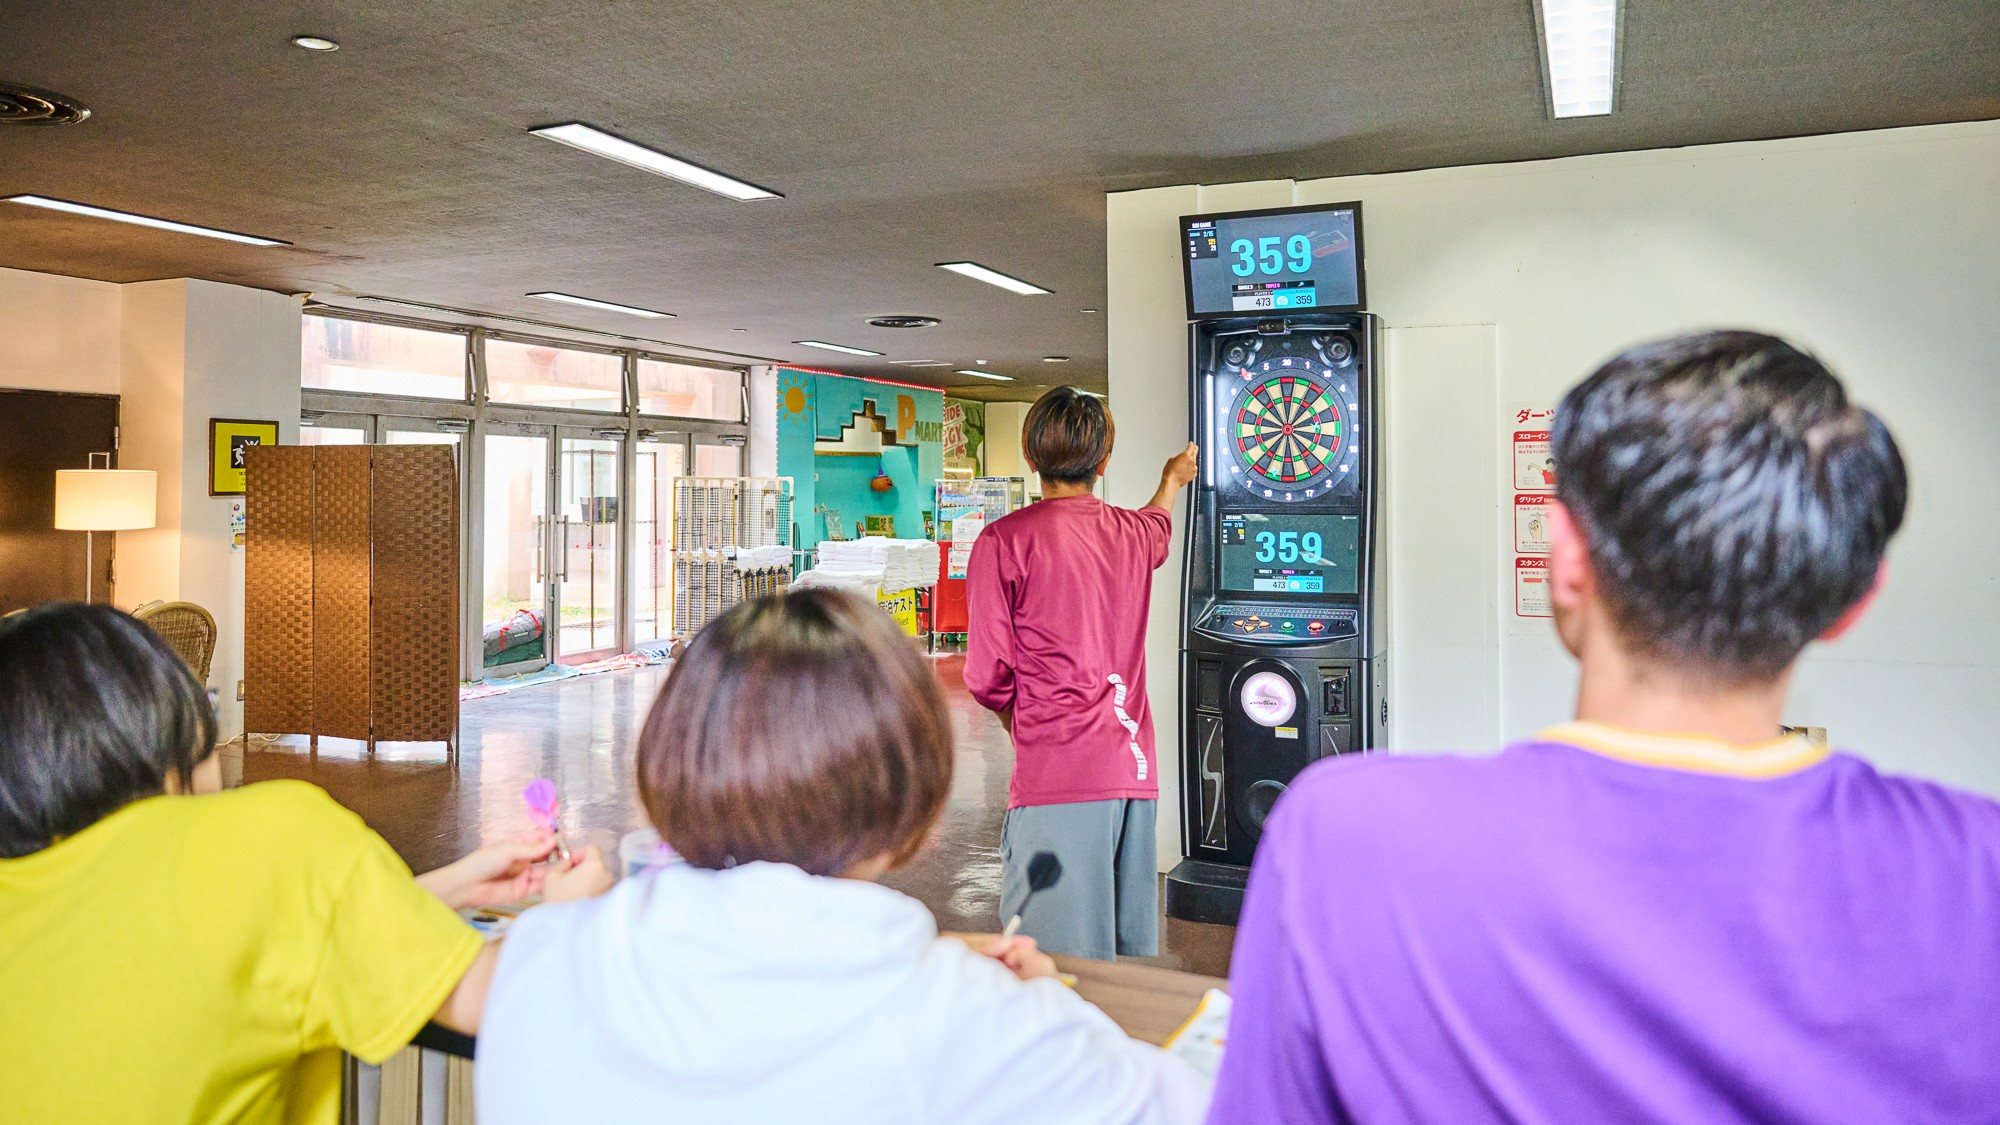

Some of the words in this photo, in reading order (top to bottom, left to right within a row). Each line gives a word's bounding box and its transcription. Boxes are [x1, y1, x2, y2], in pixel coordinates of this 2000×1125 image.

[1230, 234, 1312, 277] 359
[1256, 297, 1271, 307] 473
[1295, 295, 1312, 305] 359
[1263, 362, 1270, 370] 5
[1305, 361, 1310, 369] 1
[1339, 384, 1346, 392] 4
[896, 394, 916, 440] P
[1325, 480, 1332, 488] 2
[1285, 492, 1292, 500] 3
[1255, 531, 1322, 564] 359
[1272, 581, 1286, 589] 473
[1306, 582, 1320, 590] 359
